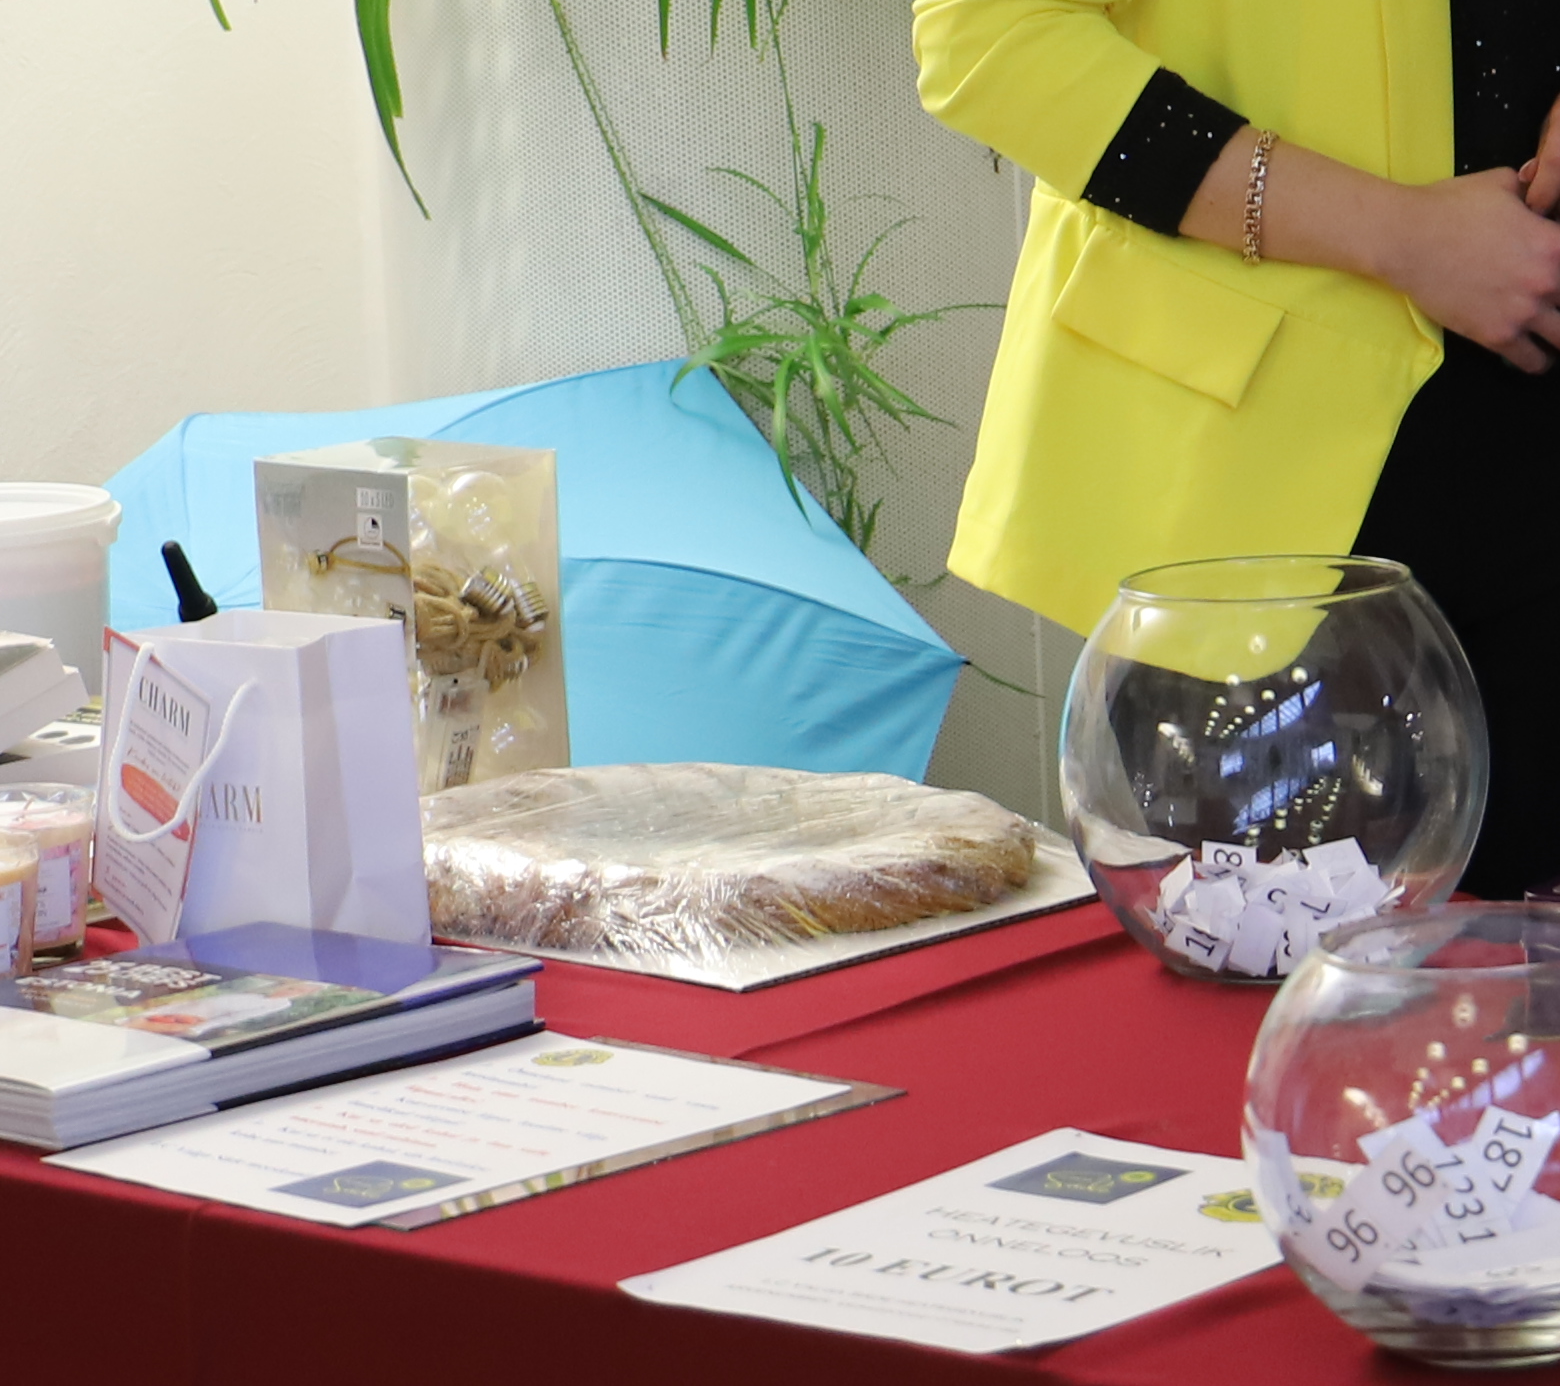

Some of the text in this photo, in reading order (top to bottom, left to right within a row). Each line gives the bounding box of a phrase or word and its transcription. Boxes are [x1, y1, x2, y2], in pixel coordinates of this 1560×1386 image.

[139, 676, 190, 737] CHARM
[800, 1246, 1115, 1304] 10 EUROT
